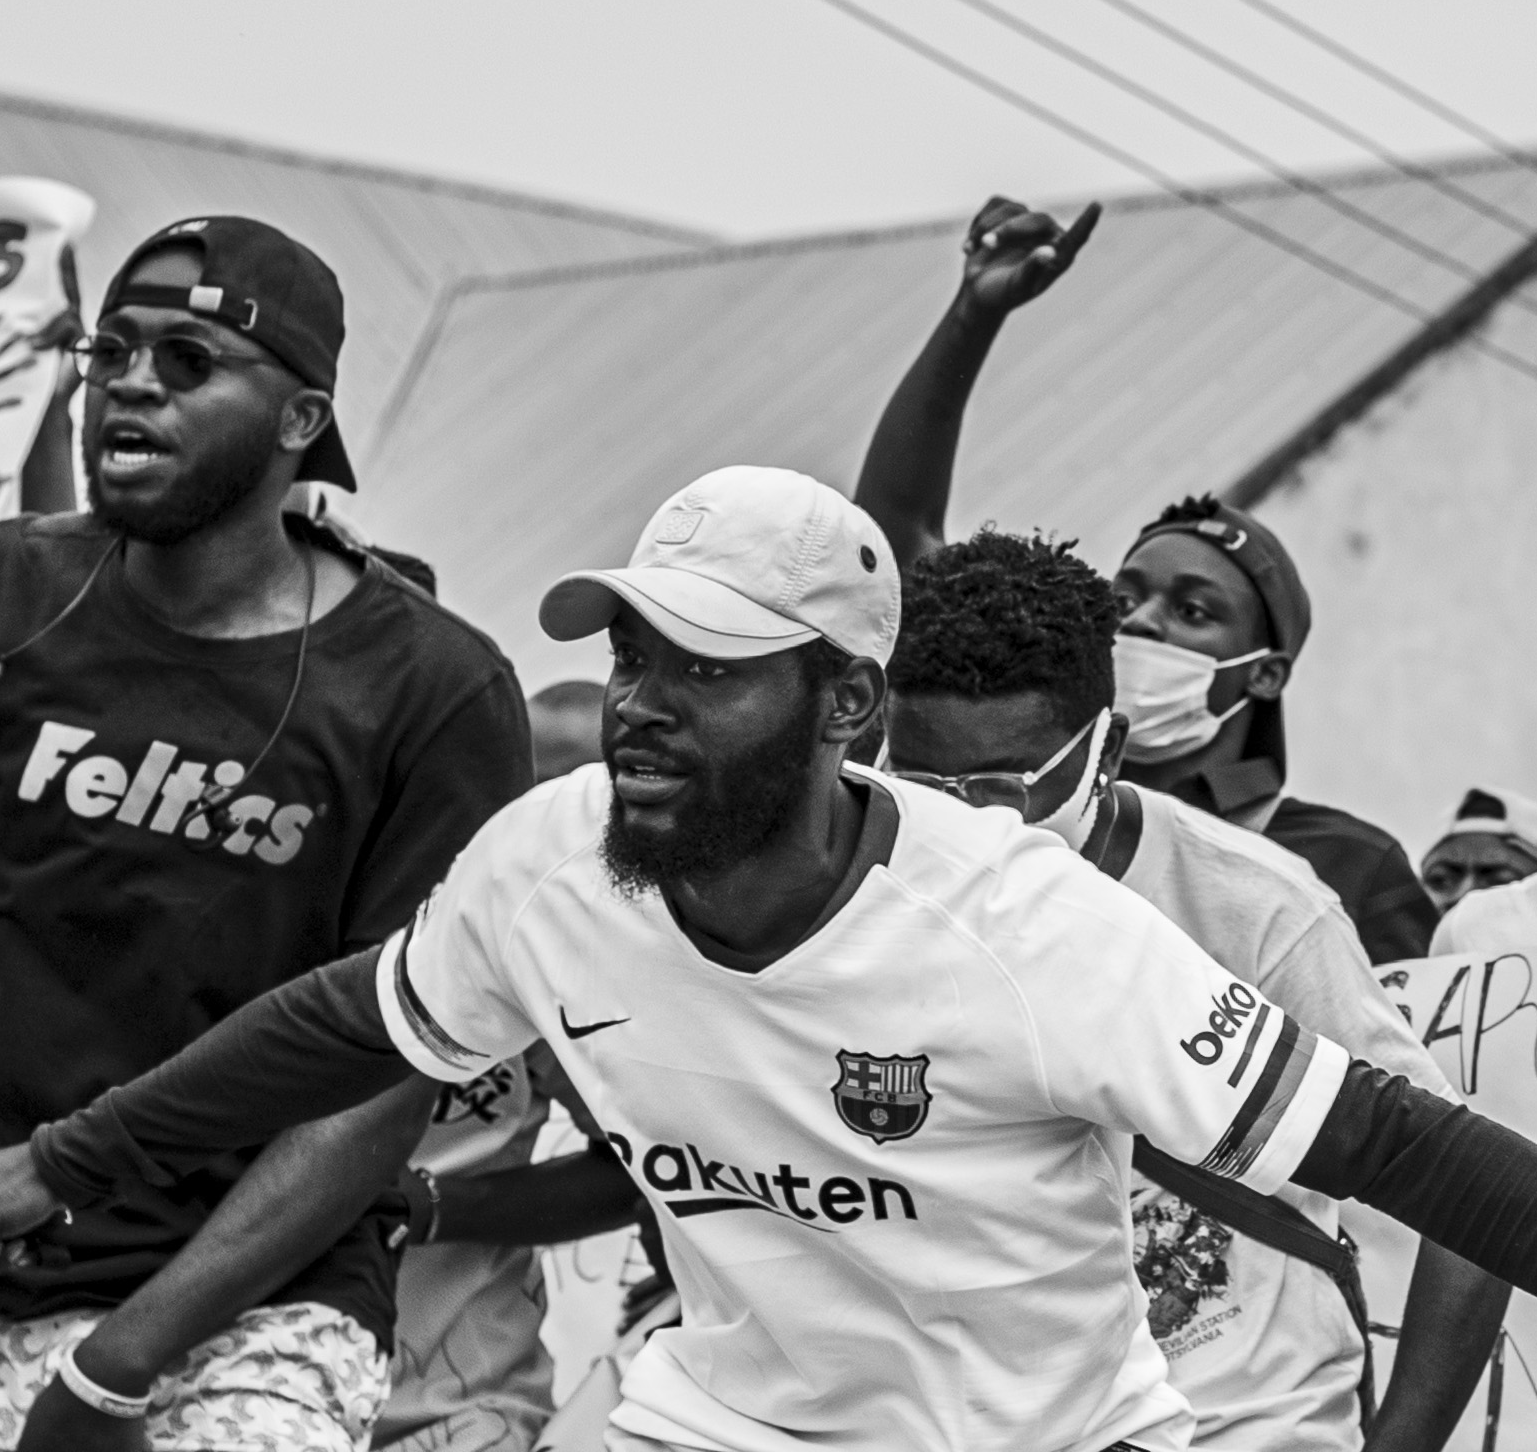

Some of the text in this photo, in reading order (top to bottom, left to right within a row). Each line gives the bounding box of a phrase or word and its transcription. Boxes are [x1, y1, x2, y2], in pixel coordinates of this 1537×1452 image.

[18, 720, 313, 864] Feltics
[1180, 982, 1256, 1066] beko
[863, 1090, 897, 1103] FCB
